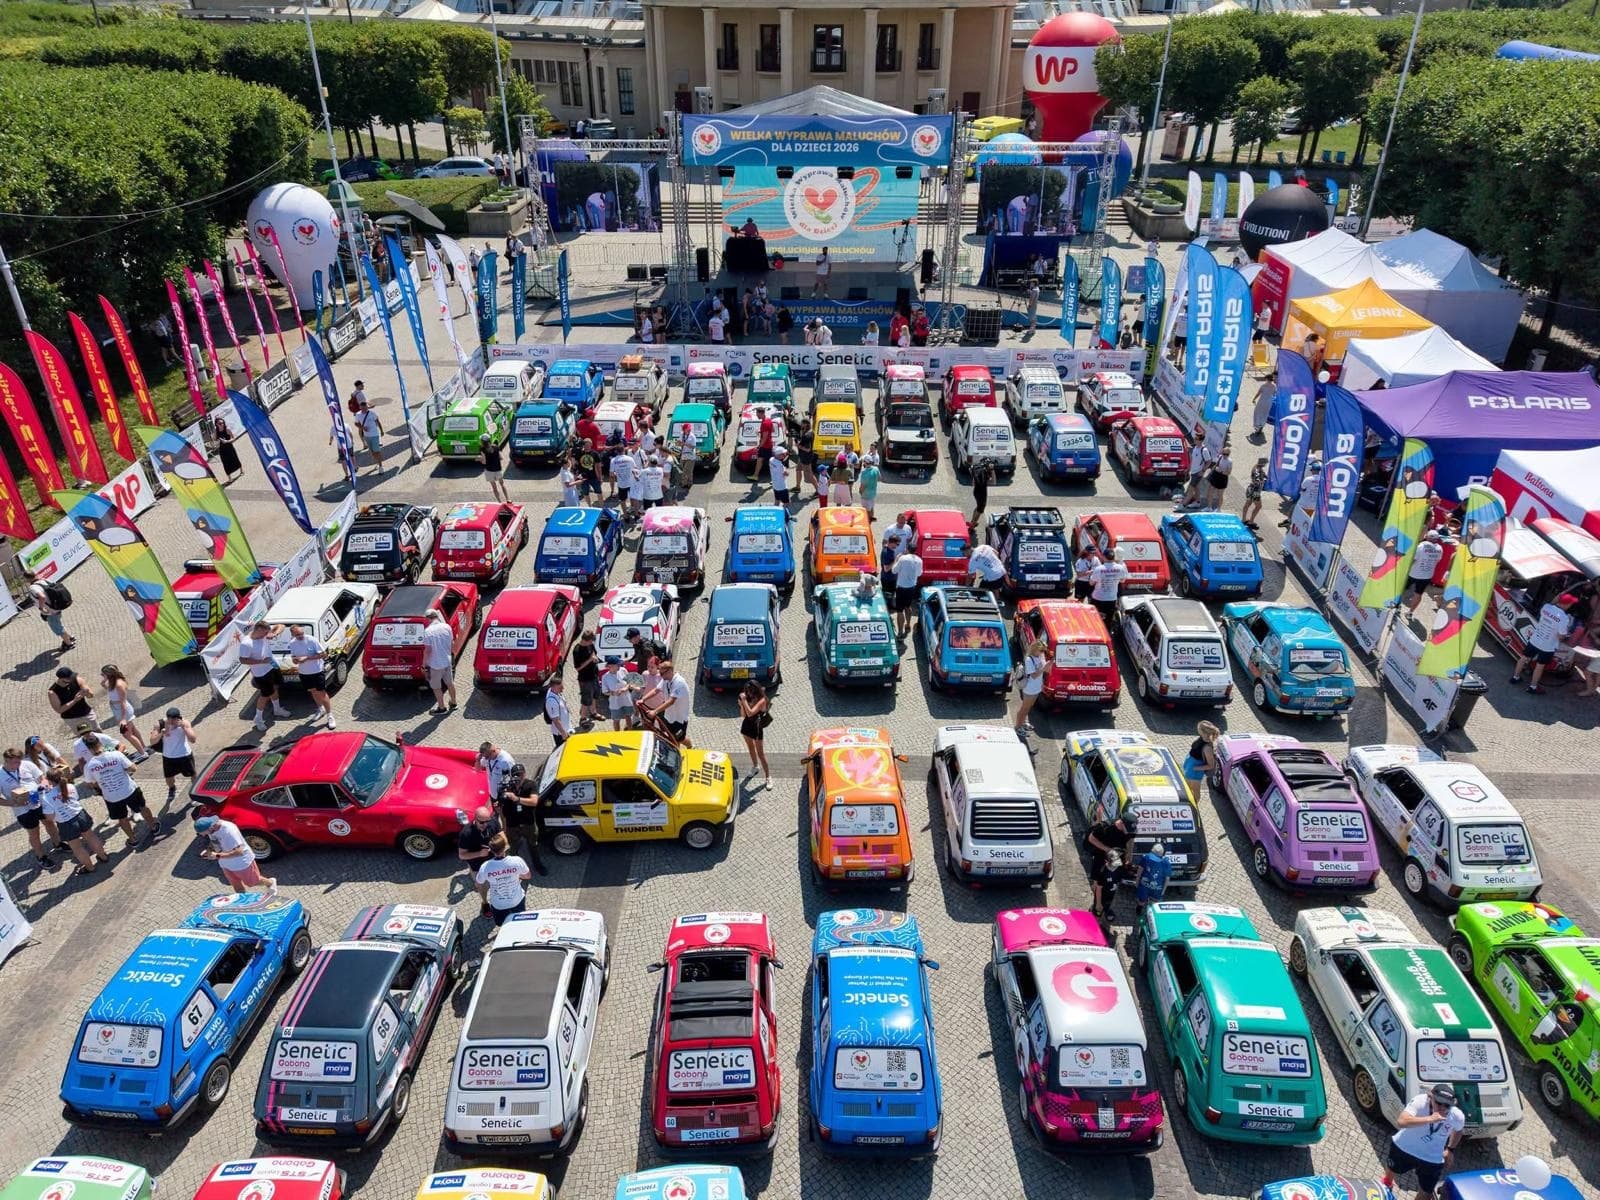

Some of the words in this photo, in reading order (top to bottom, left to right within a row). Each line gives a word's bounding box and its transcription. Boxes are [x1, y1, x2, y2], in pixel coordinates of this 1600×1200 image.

[1035, 54, 1078, 85] WP
[730, 130, 771, 141] WIELKA
[775, 130, 832, 141] WYPRAWA
[835, 127, 901, 141] MALUCHÓW
[771, 142, 792, 153] DLA
[795, 142, 831, 153] DZIECI
[833, 142, 860, 153] 2026
[483, 279, 491, 320] Senetic
[838, 305, 893, 315] MALUCHÓW
[1351, 306, 1405, 321] LEIBNIZ
[837, 316, 859, 324] 2026
[1333, 329, 1362, 338] LEIBNIZ
[753, 352, 809, 366] Senetic
[816, 352, 873, 366] Senetic
[1082, 361, 1096, 370] WP
[265, 369, 290, 395] MOTO
[1468, 396, 1591, 410] POLARIS
[518, 419, 548, 427] Senetic
[820, 422, 851, 430] Senetic
[976, 427, 1006, 435] Senetic
[1525, 472, 1554, 499] Baltona
[350, 534, 388, 544] Senetic
[1021, 543, 1059, 552] Senetic
[618, 596, 647, 605] 80
[1501, 606, 1514, 622] 80
[488, 628, 532, 639] Senetic
[717, 627, 761, 636] Senetic
[840, 623, 884, 633] Senetic
[1172, 644, 1217, 655] Senetic
[91, 759, 118, 773] POLAND
[572, 787, 585, 799] 55
[1133, 807, 1187, 819] Senetic
[1302, 813, 1358, 826] Senetic
[615, 825, 664, 834] THUNDER
[1464, 831, 1519, 844] Senetic
[990, 850, 1024, 859] Senetic
[487, 867, 517, 877] POLAND
[1485, 875, 1516, 884] Senetic
[126, 969, 185, 988] Senetic
[1406, 966, 1434, 996] group
[240, 963, 274, 1014] Senetic
[845, 992, 909, 1007] Senetic
[187, 1004, 203, 1026] 67
[284, 1028, 292, 1036] 66
[377, 1018, 390, 1039] 66
[562, 1024, 571, 1043] 65
[279, 1042, 347, 1060] Senetic
[1229, 1037, 1300, 1056] Senetic
[278, 1060, 310, 1068] Gabona
[468, 1051, 541, 1067] Senetic
[674, 1053, 745, 1069] Senetic
[1229, 1054, 1264, 1063] Gabona
[325, 1064, 350, 1073] moya
[1281, 1061, 1305, 1070] moya
[519, 1070, 543, 1079] moya
[725, 1073, 748, 1082] moya
[458, 1105, 466, 1113] 65
[1247, 1103, 1293, 1117] Senetic
[288, 1110, 328, 1121] Senetic
[481, 1118, 522, 1129] Senetic
[667, 1118, 675, 1127] 60
[689, 1129, 730, 1140] Senetic
[35, 1161, 64, 1174] moya
[82, 1160, 123, 1172] Gabona
[224, 1164, 255, 1175] moya
[272, 1160, 315, 1168] Gabona
[86, 1173, 111, 1182] STS
[481, 1171, 525, 1180] Gabona
[1480, 1173, 1519, 1186] oya
[433, 1177, 465, 1187] moya
